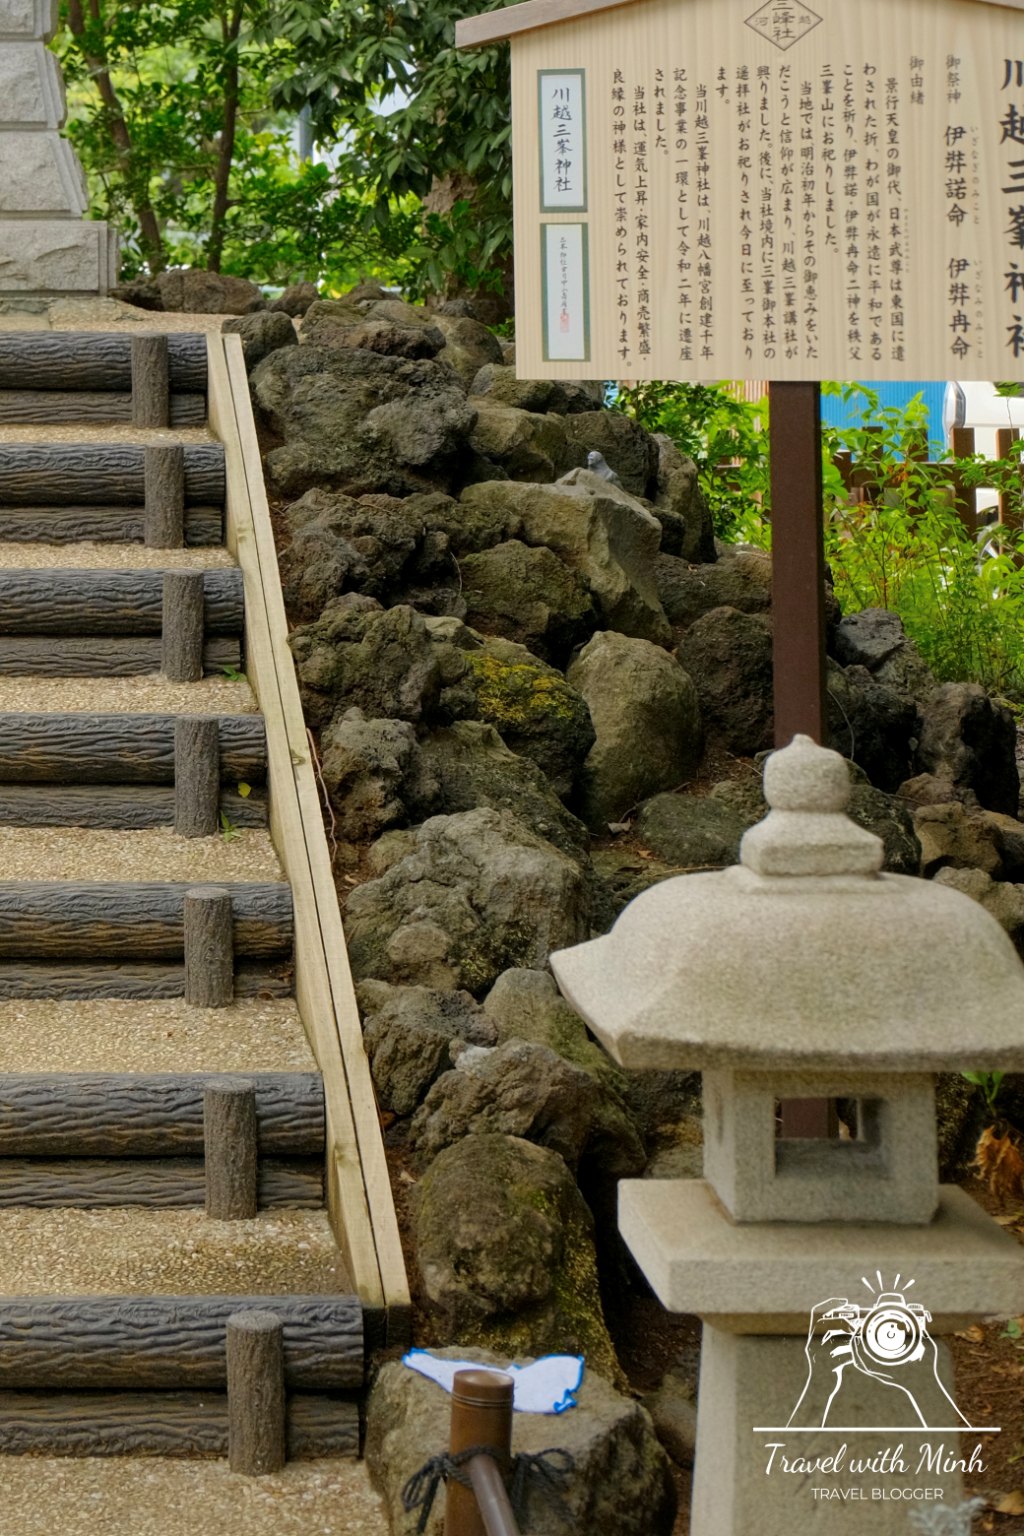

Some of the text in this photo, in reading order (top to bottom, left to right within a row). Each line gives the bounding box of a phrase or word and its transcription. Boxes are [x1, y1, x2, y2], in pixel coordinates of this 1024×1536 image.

[715, 66, 731, 105] ます。
[909, 56, 925, 104] 御由緒
[945, 54, 961, 104] 御祭神
[654, 68, 669, 156] されました。
